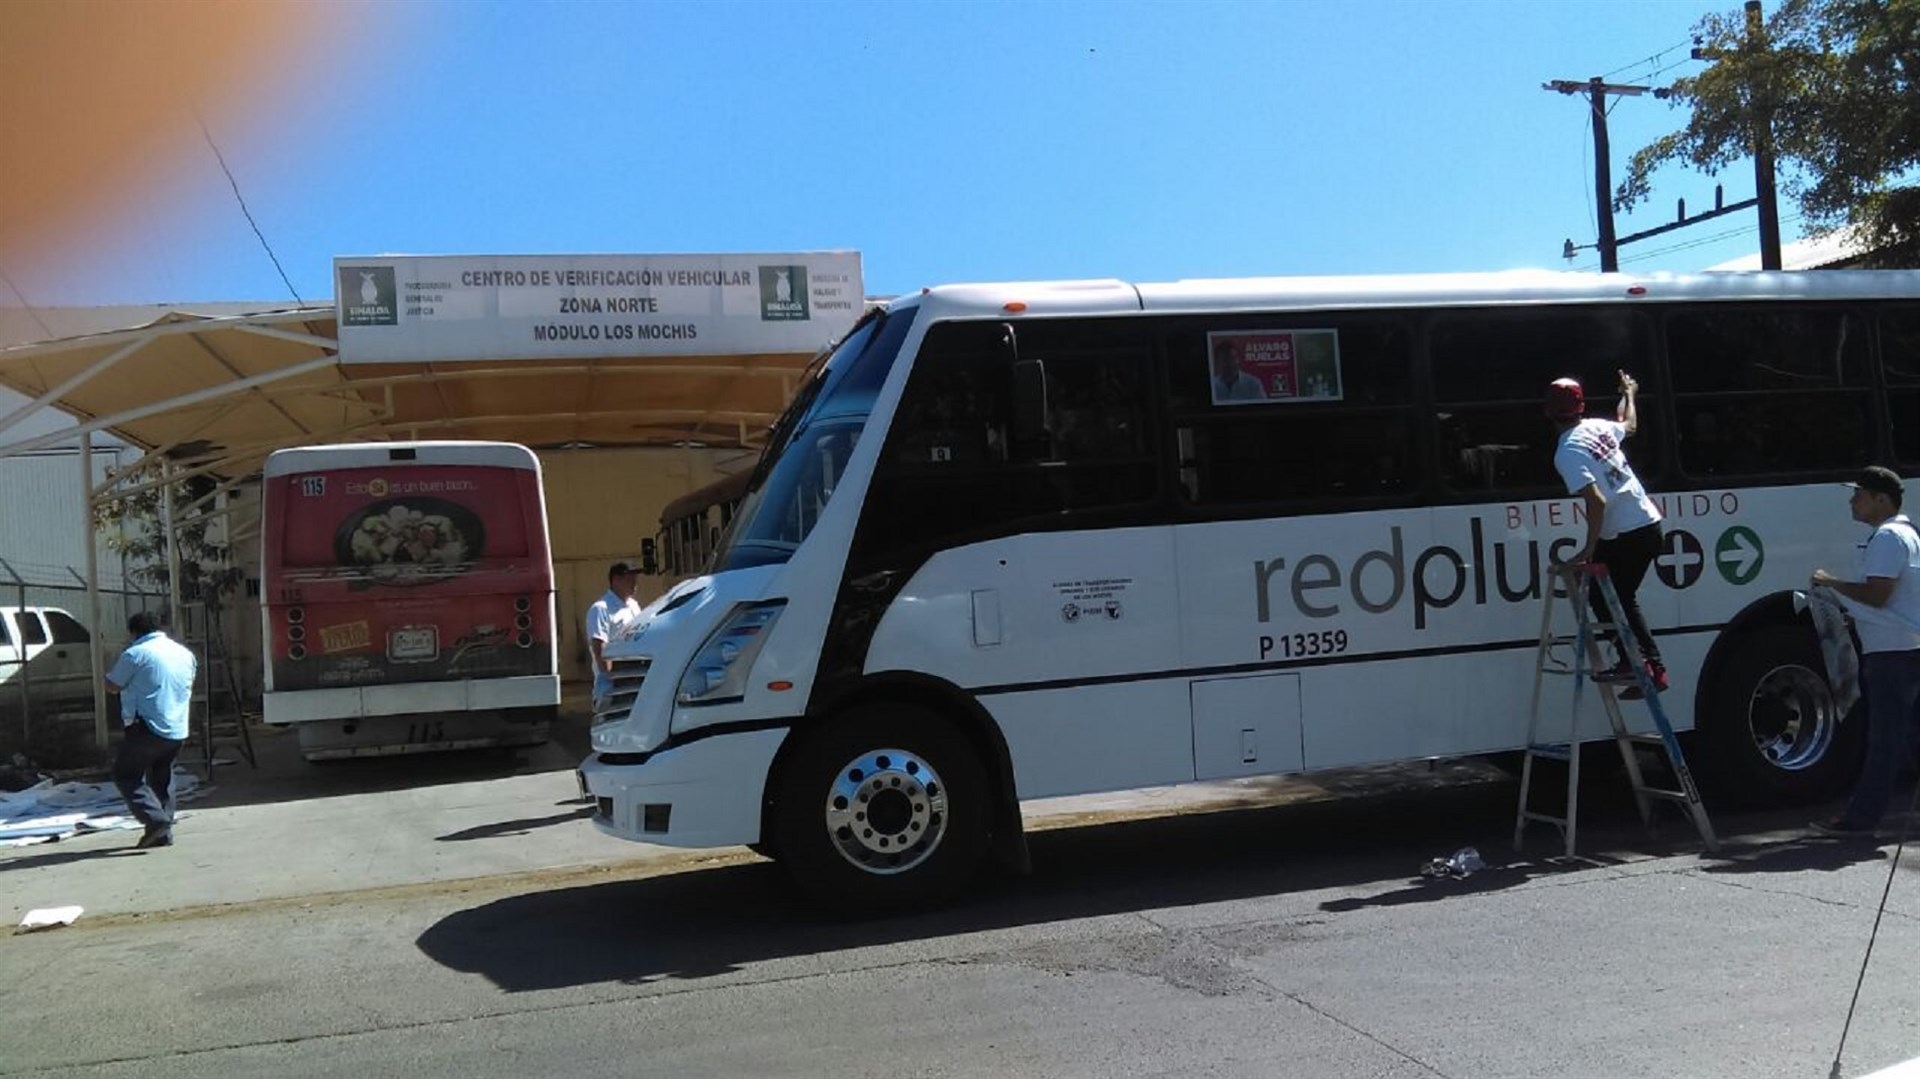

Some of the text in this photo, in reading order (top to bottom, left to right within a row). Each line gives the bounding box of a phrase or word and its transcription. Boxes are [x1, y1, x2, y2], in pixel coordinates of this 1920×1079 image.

[461, 267, 752, 287] CENTRO DE VERIFICACIÓN VEHICULAR
[560, 296, 659, 314] ZONA NORTE
[533, 323, 698, 341] MÓDULO LOS MOCHIS
[303, 478, 323, 495] 115
[1259, 629, 1349, 660] P 13359
